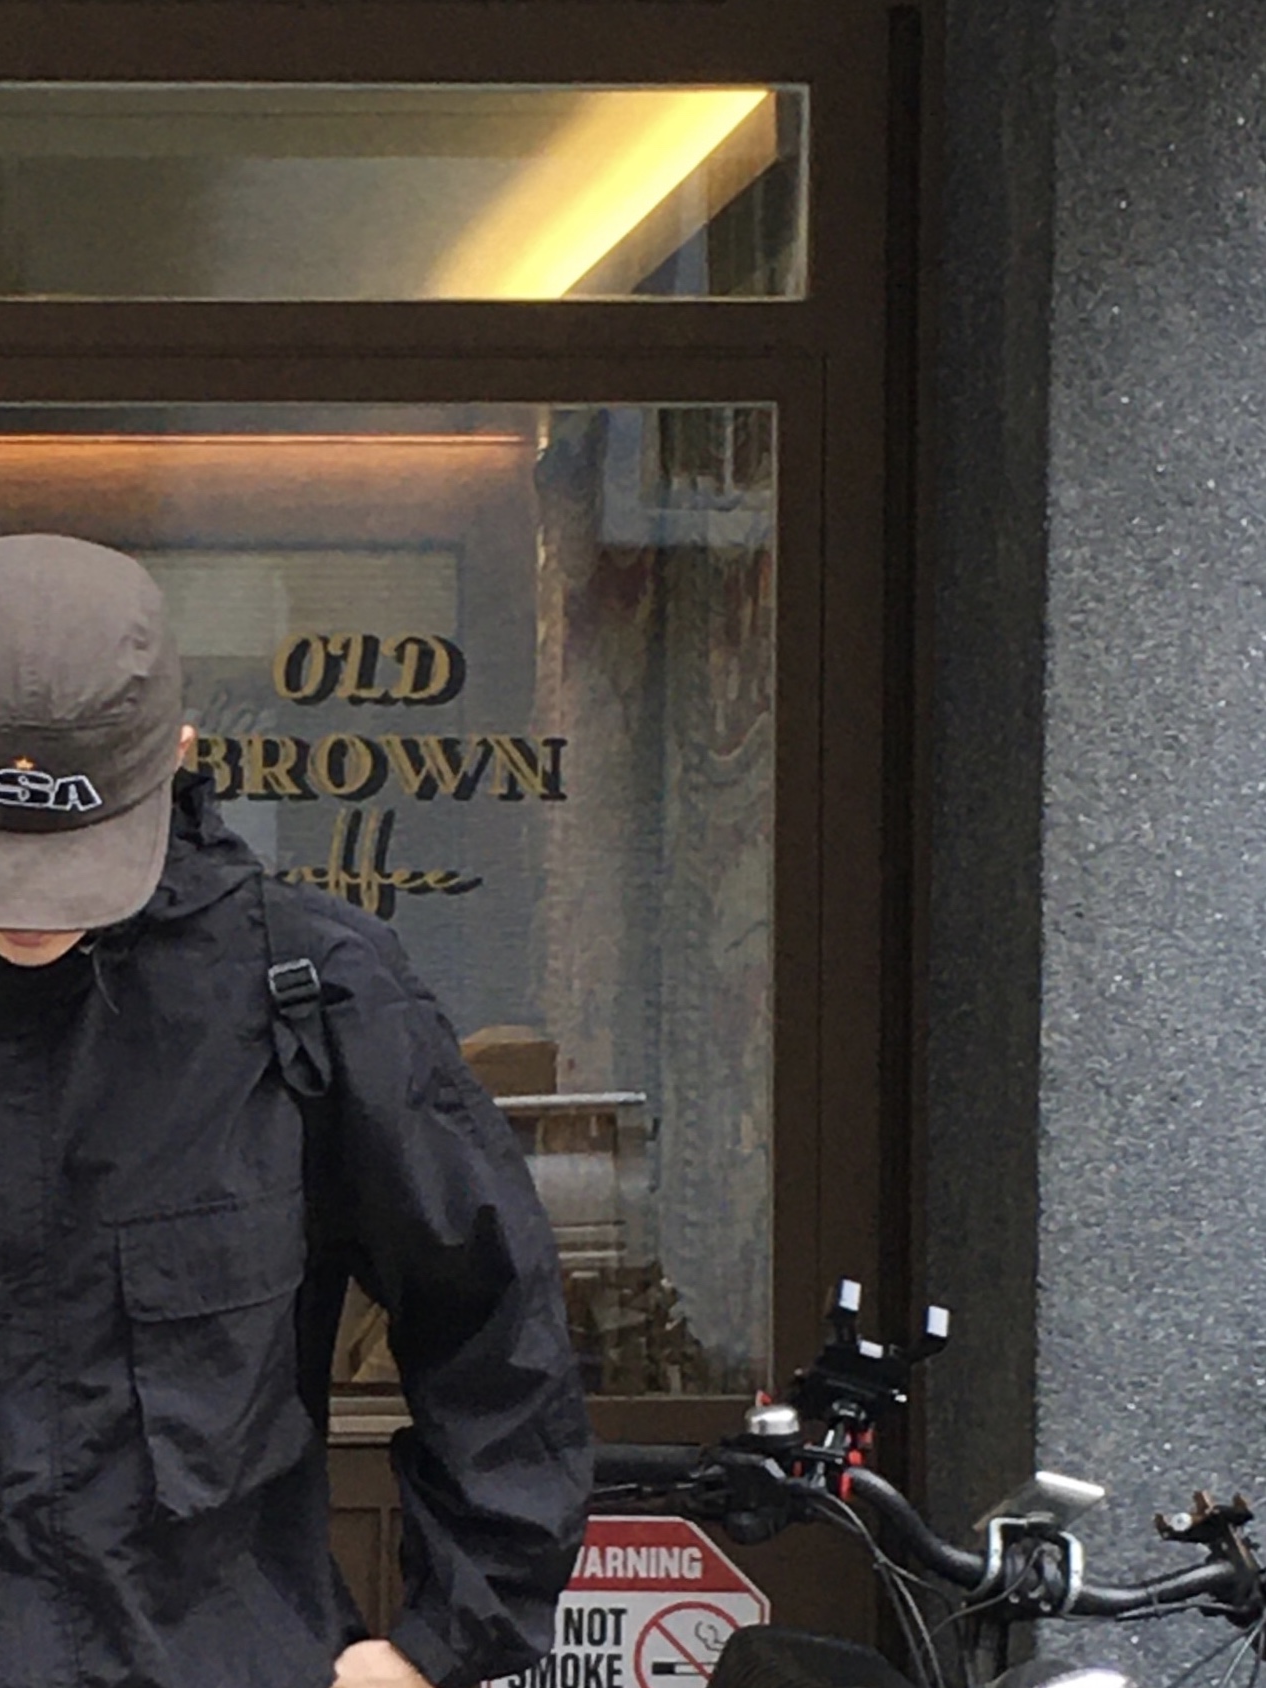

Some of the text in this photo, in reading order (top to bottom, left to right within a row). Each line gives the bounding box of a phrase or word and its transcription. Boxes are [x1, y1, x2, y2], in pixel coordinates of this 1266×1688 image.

[272, 631, 464, 704] OLD
[184, 733, 566, 800] BROWN
[562, 1607, 627, 1647] NOT
